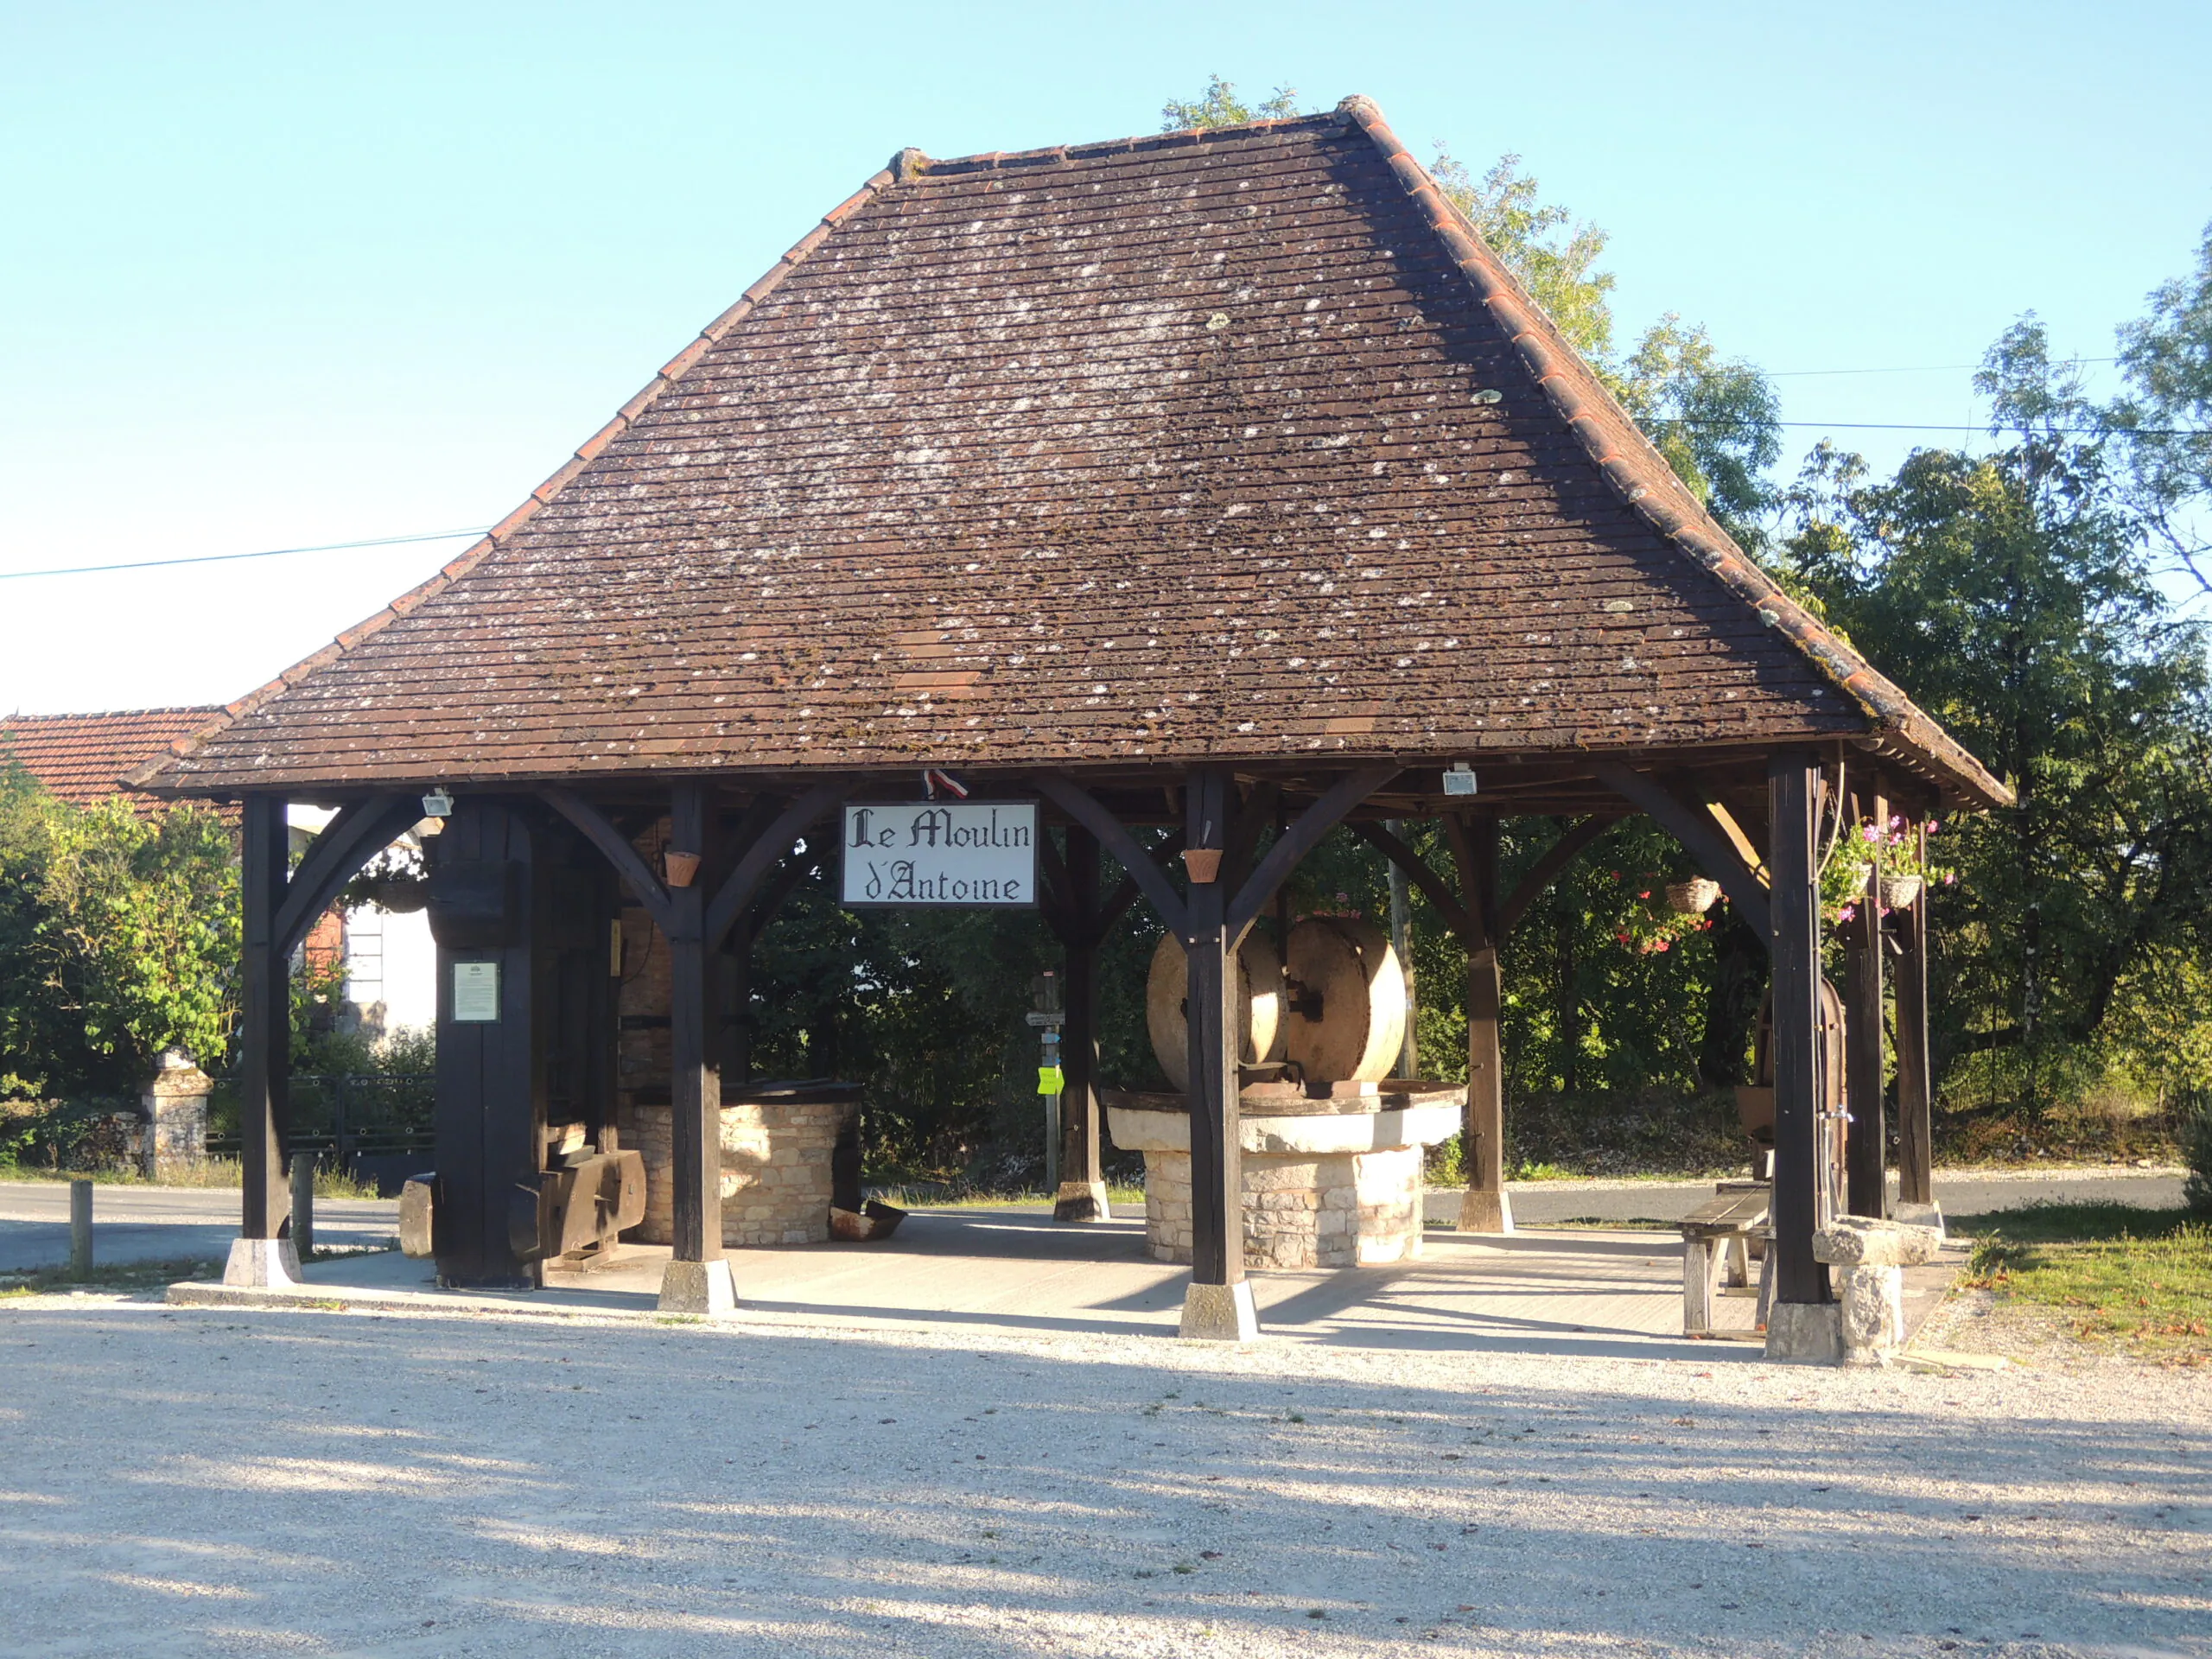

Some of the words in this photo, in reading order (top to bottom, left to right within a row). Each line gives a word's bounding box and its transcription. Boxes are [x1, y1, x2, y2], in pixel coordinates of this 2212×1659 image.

[848, 808, 896, 849] Le
[906, 808, 1030, 849] Moulin
[865, 860, 1021, 900] d'Antoine
